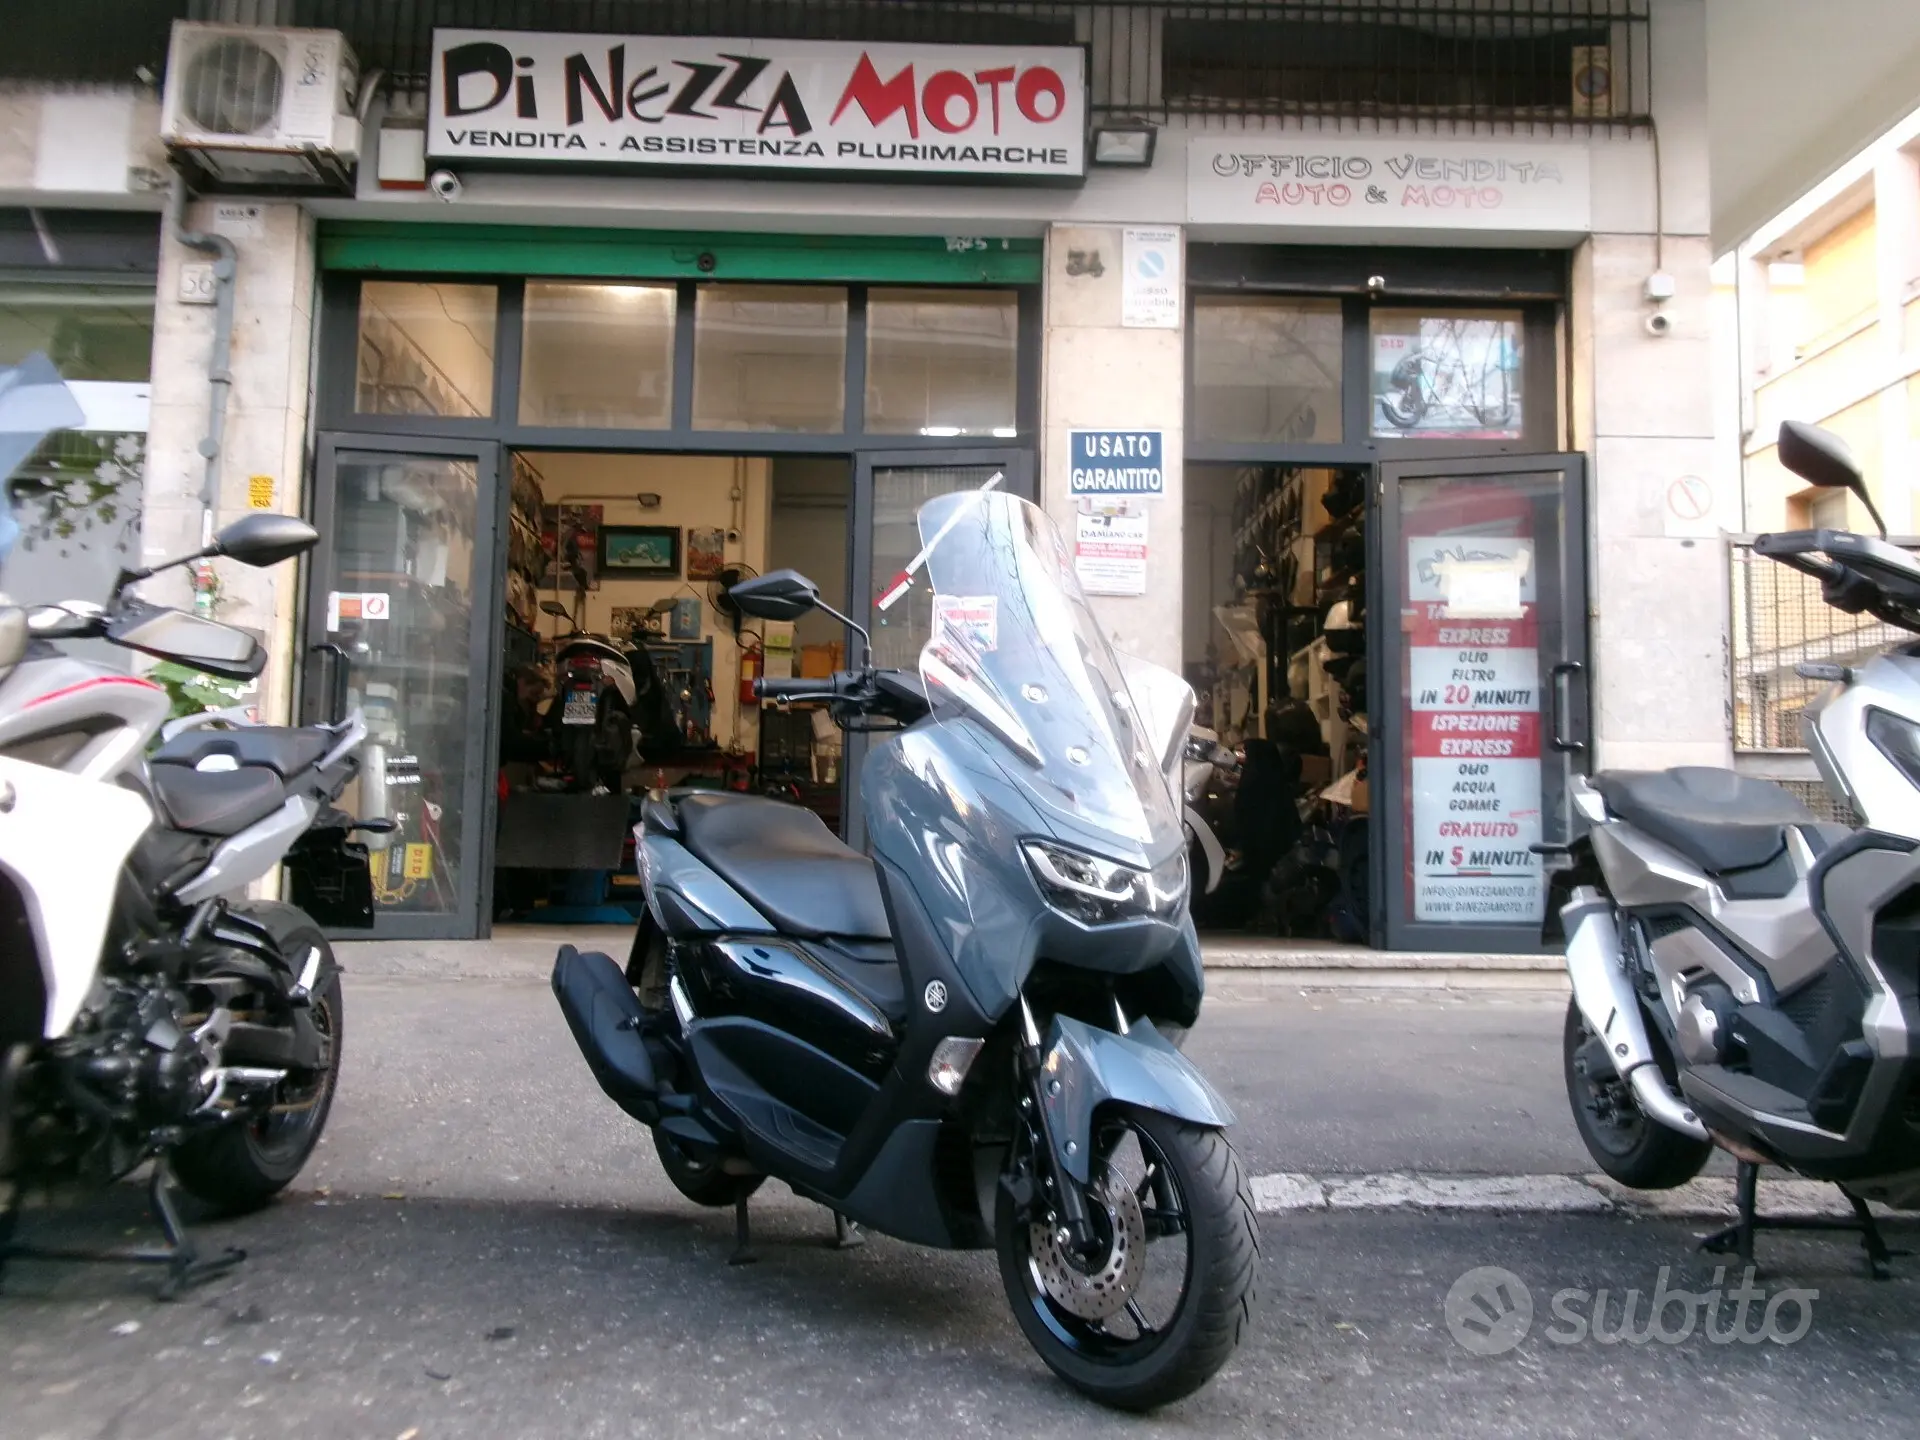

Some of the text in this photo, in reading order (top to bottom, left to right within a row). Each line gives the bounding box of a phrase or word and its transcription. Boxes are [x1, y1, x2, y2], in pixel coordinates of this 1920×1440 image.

[829, 51, 1066, 139] MOTO
[446, 129, 587, 149] VENDITA
[619, 135, 825, 157] ASSISTENZA
[837, 141, 1068, 164] PLURIMARCHE
[1212, 153, 1563, 184] UFFICIO VENDITA
[1255, 181, 1504, 210] AUTO & MOTO
[1085, 435, 1151, 457] USATO
[1072, 467, 1161, 490] GARANTITO
[1439, 628, 1510, 645] EXPRESS
[1459, 652, 1488, 663] OLIO
[1451, 669, 1495, 681] FILTRO
[1420, 684, 1531, 705] IN 20 MINUTI
[1432, 715, 1521, 732] ISPEZIONE
[1440, 738, 1514, 756] EXPRESS
[1458, 763, 1489, 775] OLIO
[1452, 782, 1496, 794] ACQUA
[1449, 799, 1501, 811] GOMME
[1439, 822, 1519, 838] GRATUITO
[1425, 850, 1444, 866] IN
[1450, 846, 1464, 866] 5
